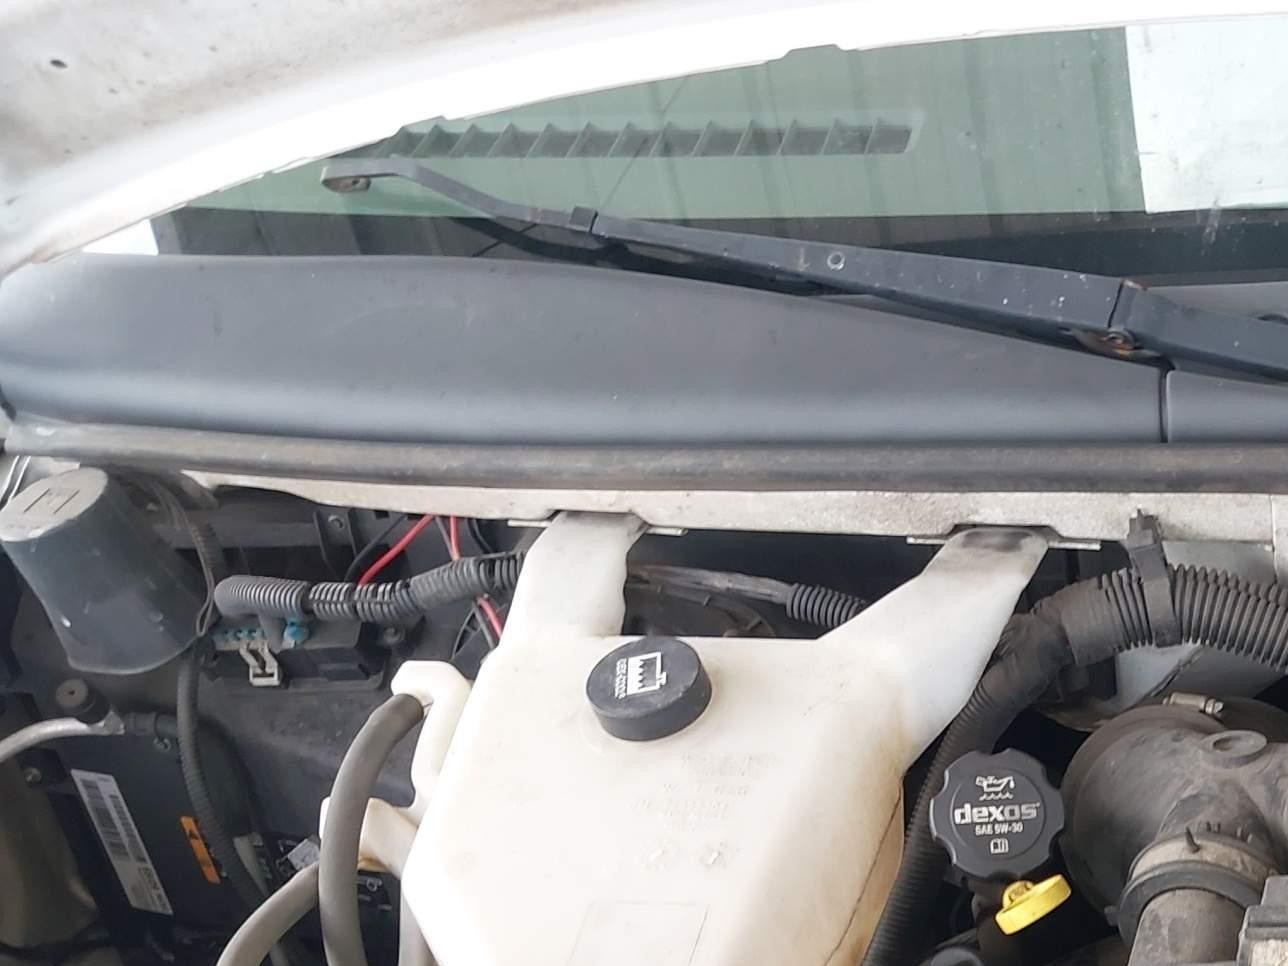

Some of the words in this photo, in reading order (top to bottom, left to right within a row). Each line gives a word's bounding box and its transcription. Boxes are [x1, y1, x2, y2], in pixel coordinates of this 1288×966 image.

[954, 803, 1039, 825] dexos
[975, 824, 993, 836] SAE
[994, 821, 1023, 835] 5W-30
